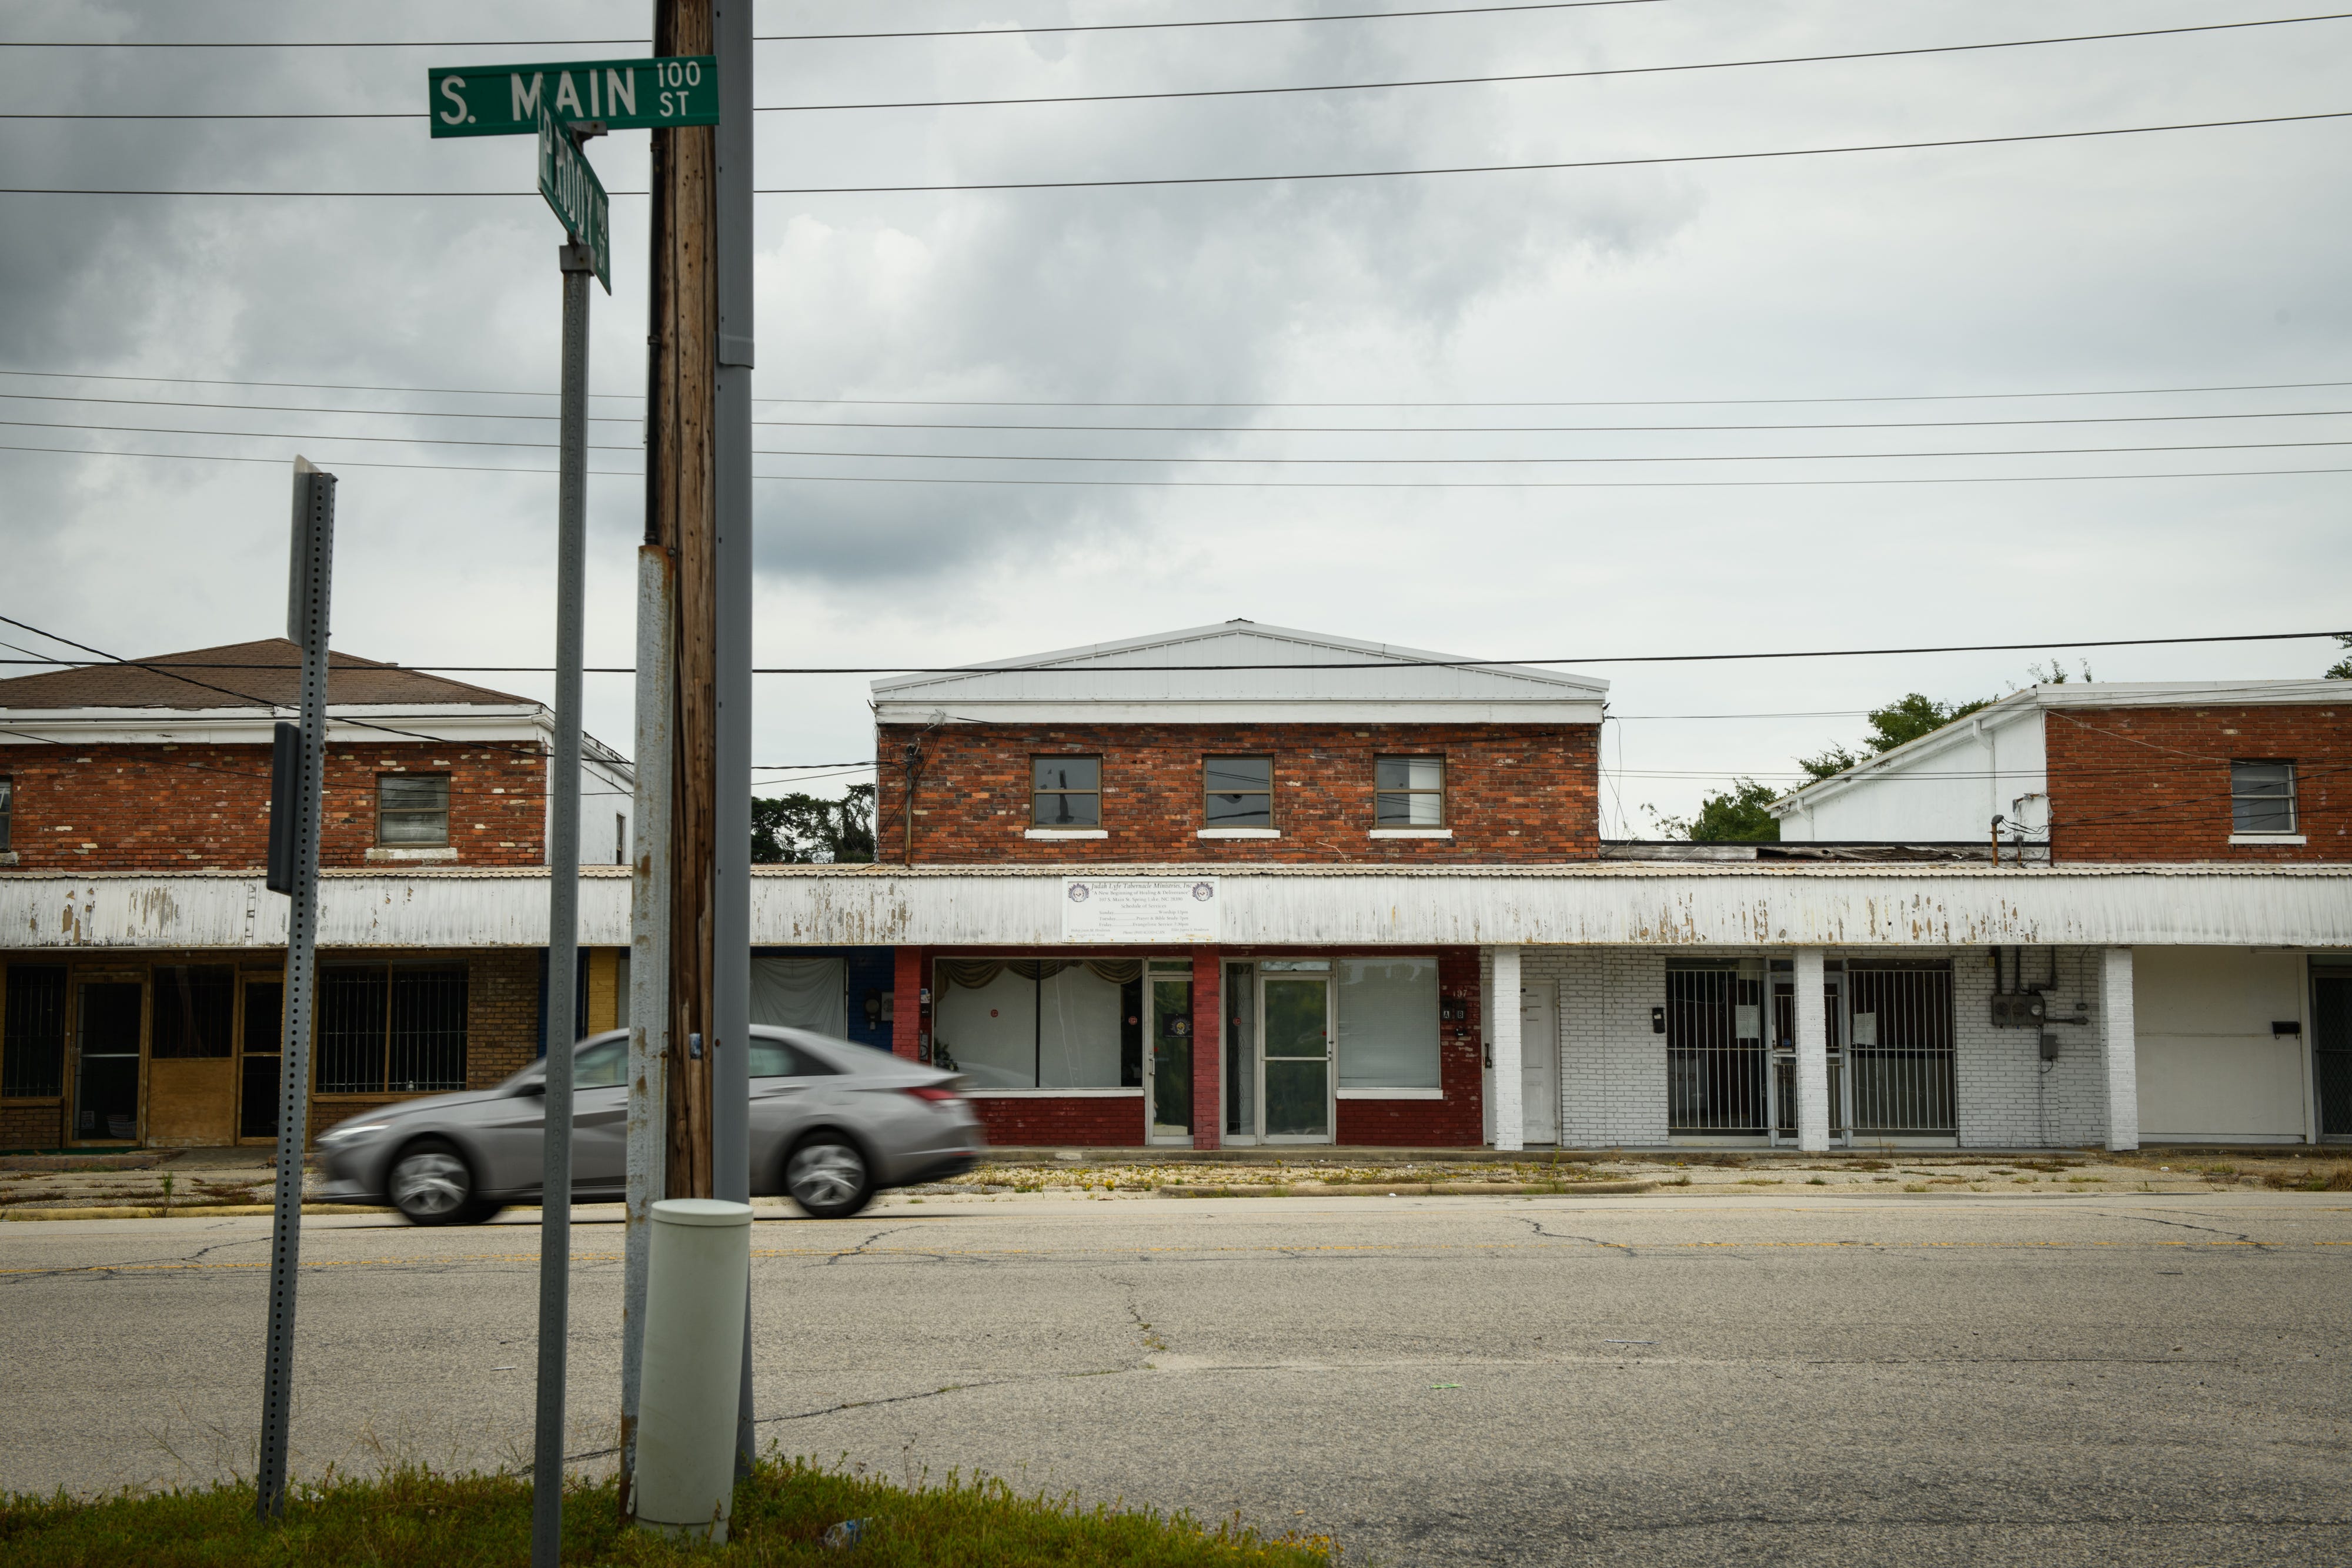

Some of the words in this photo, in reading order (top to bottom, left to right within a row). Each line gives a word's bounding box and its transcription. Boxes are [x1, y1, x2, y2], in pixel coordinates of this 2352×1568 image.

[657, 61, 701, 88] 100
[440, 75, 476, 125] S.
[510, 67, 636, 121] MAIN
[660, 91, 689, 117] ST
[1091, 882, 1107, 891] Judah
[1108, 882, 1121, 891] Lyfe
